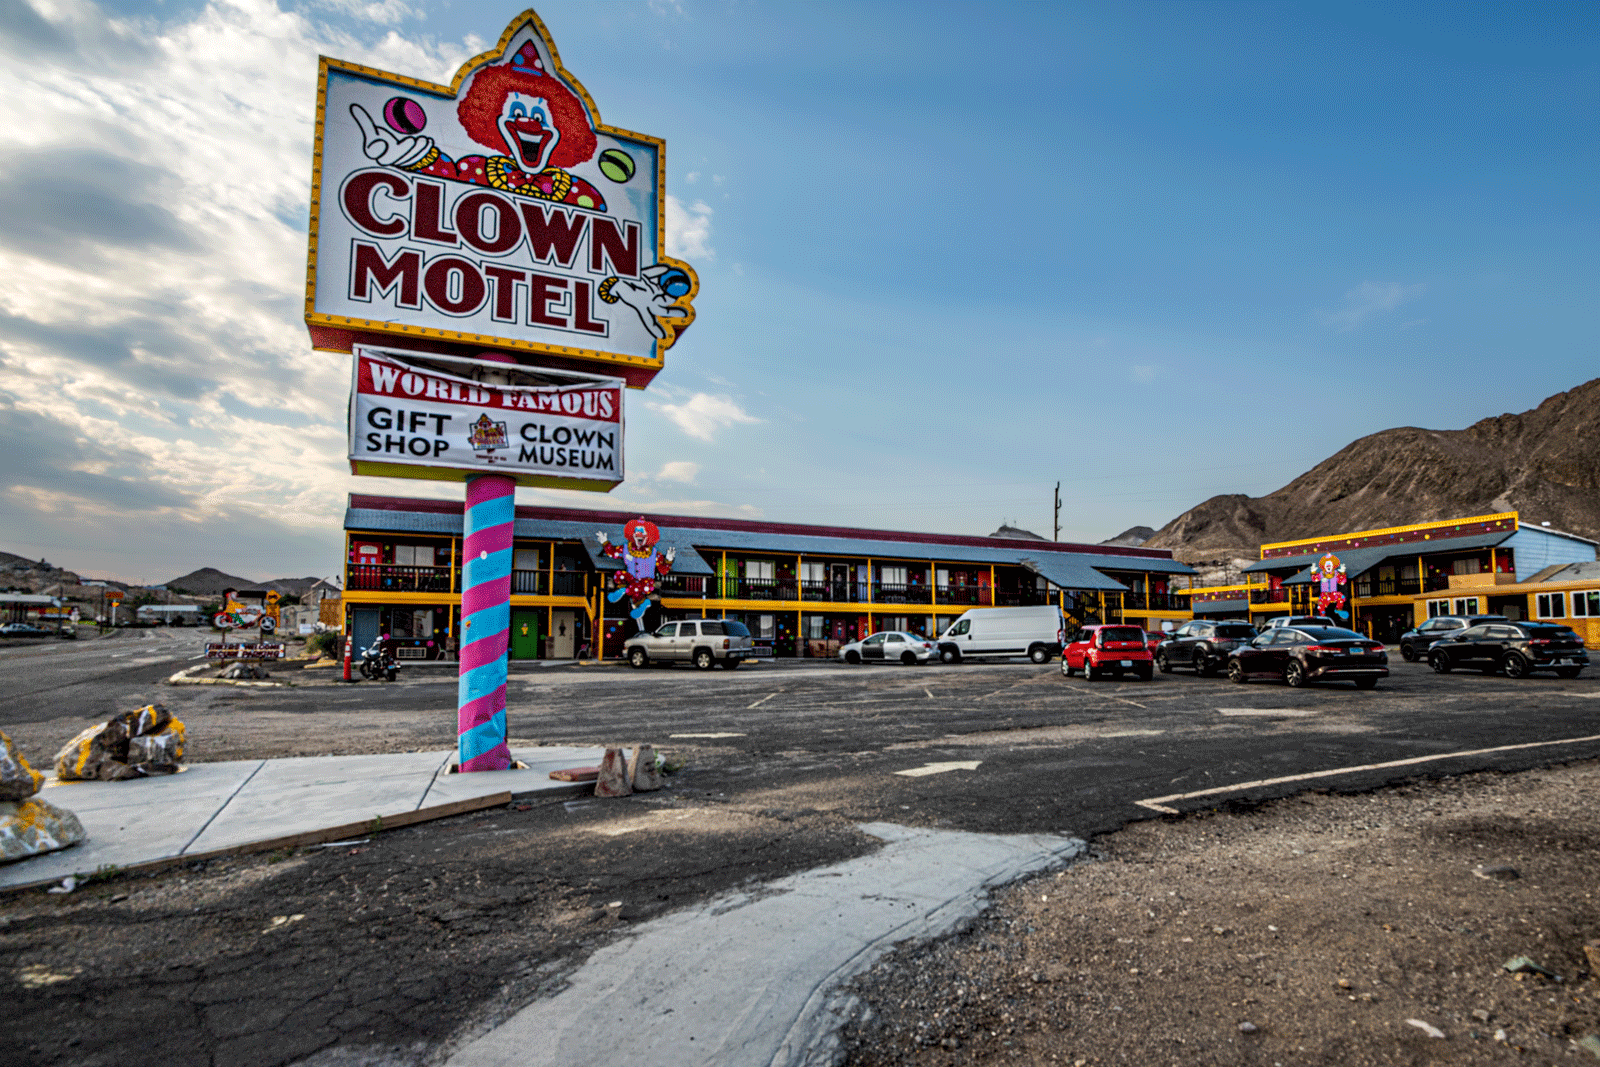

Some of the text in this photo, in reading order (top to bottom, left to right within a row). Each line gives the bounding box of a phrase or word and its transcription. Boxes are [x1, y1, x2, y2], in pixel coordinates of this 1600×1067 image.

[339, 167, 642, 280] CLOWN
[348, 238, 610, 338] MOTEL
[368, 361, 613, 419] WORLD FAMOUS
[367, 407, 452, 436] GIFT
[519, 422, 614, 450] CLOWN
[366, 432, 450, 458] SHOP
[518, 445, 614, 471] MUSEUM
